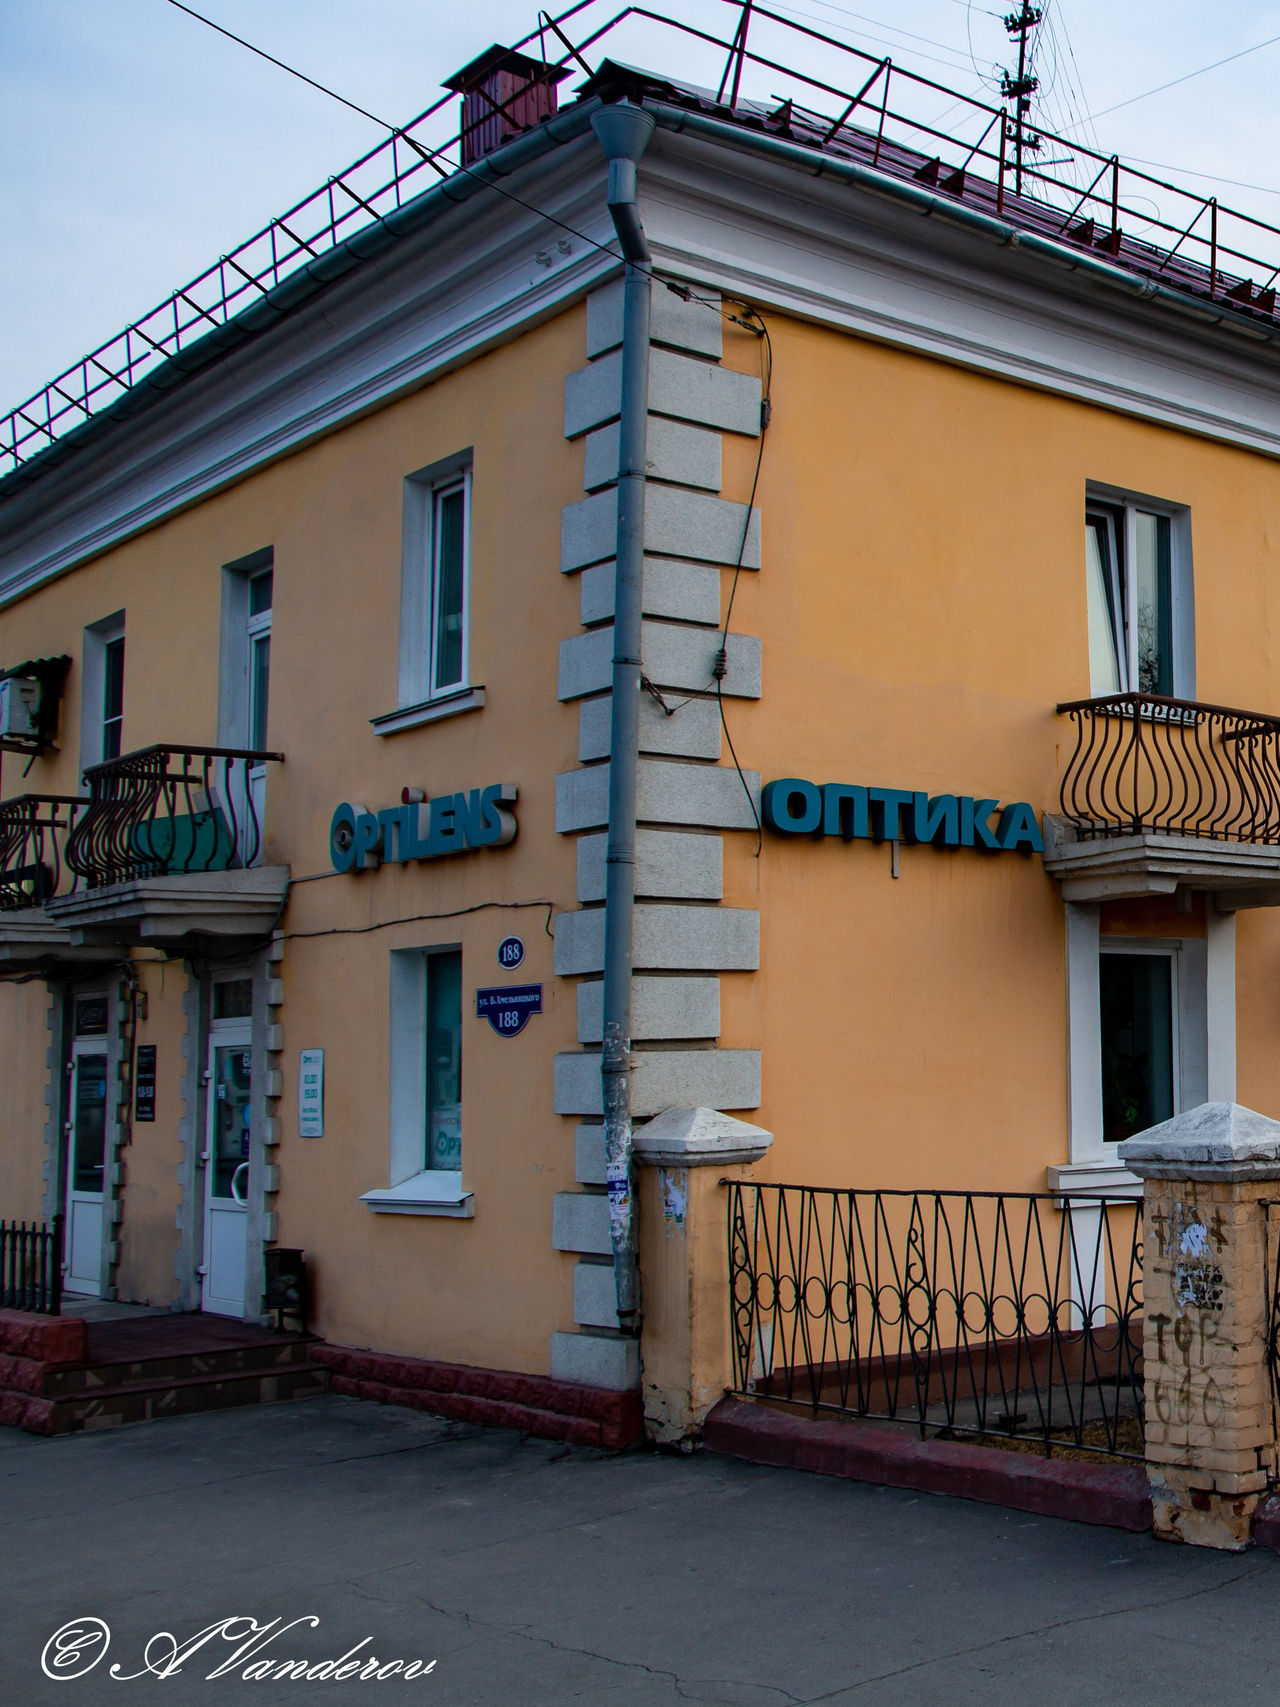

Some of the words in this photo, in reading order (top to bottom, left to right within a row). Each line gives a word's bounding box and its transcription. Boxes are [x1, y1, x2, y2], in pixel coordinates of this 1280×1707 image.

[762, 778, 1046, 852] ОПТИКА
[502, 943, 520, 962] 188
[498, 1011, 518, 1028] 188
